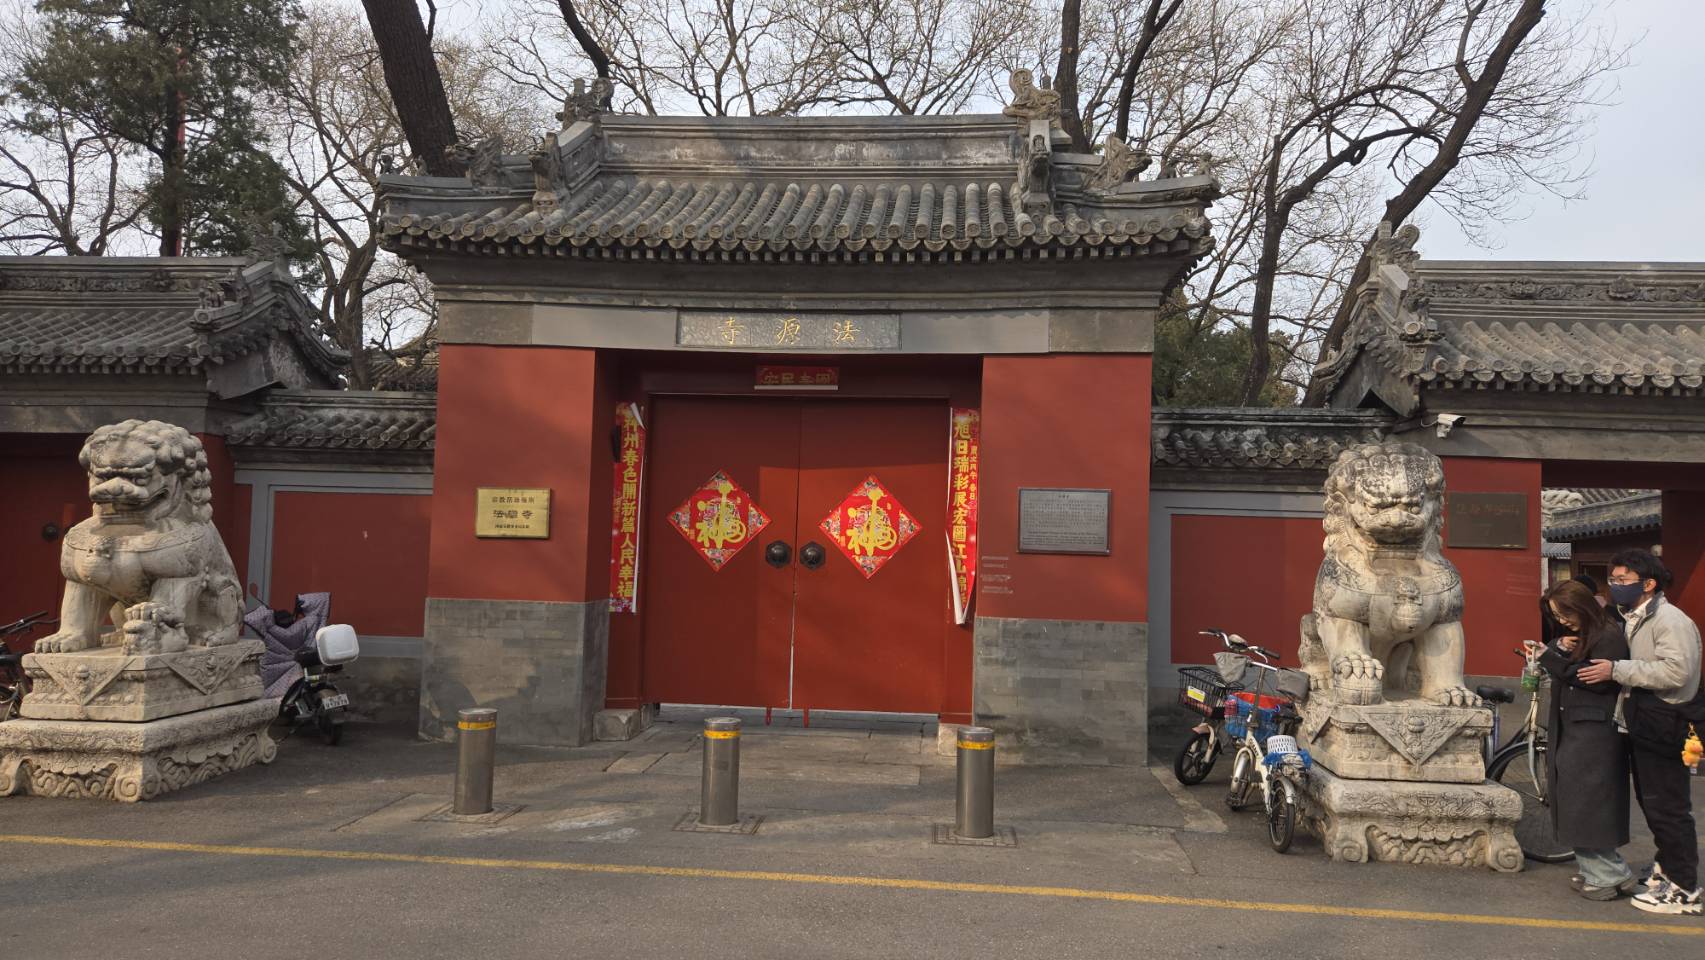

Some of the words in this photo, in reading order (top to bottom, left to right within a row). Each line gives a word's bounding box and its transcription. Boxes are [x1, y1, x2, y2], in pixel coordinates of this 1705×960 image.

[717, 316, 861, 345] 法源寺
[696, 483, 747, 549] 福
[846, 488, 897, 556] 福
